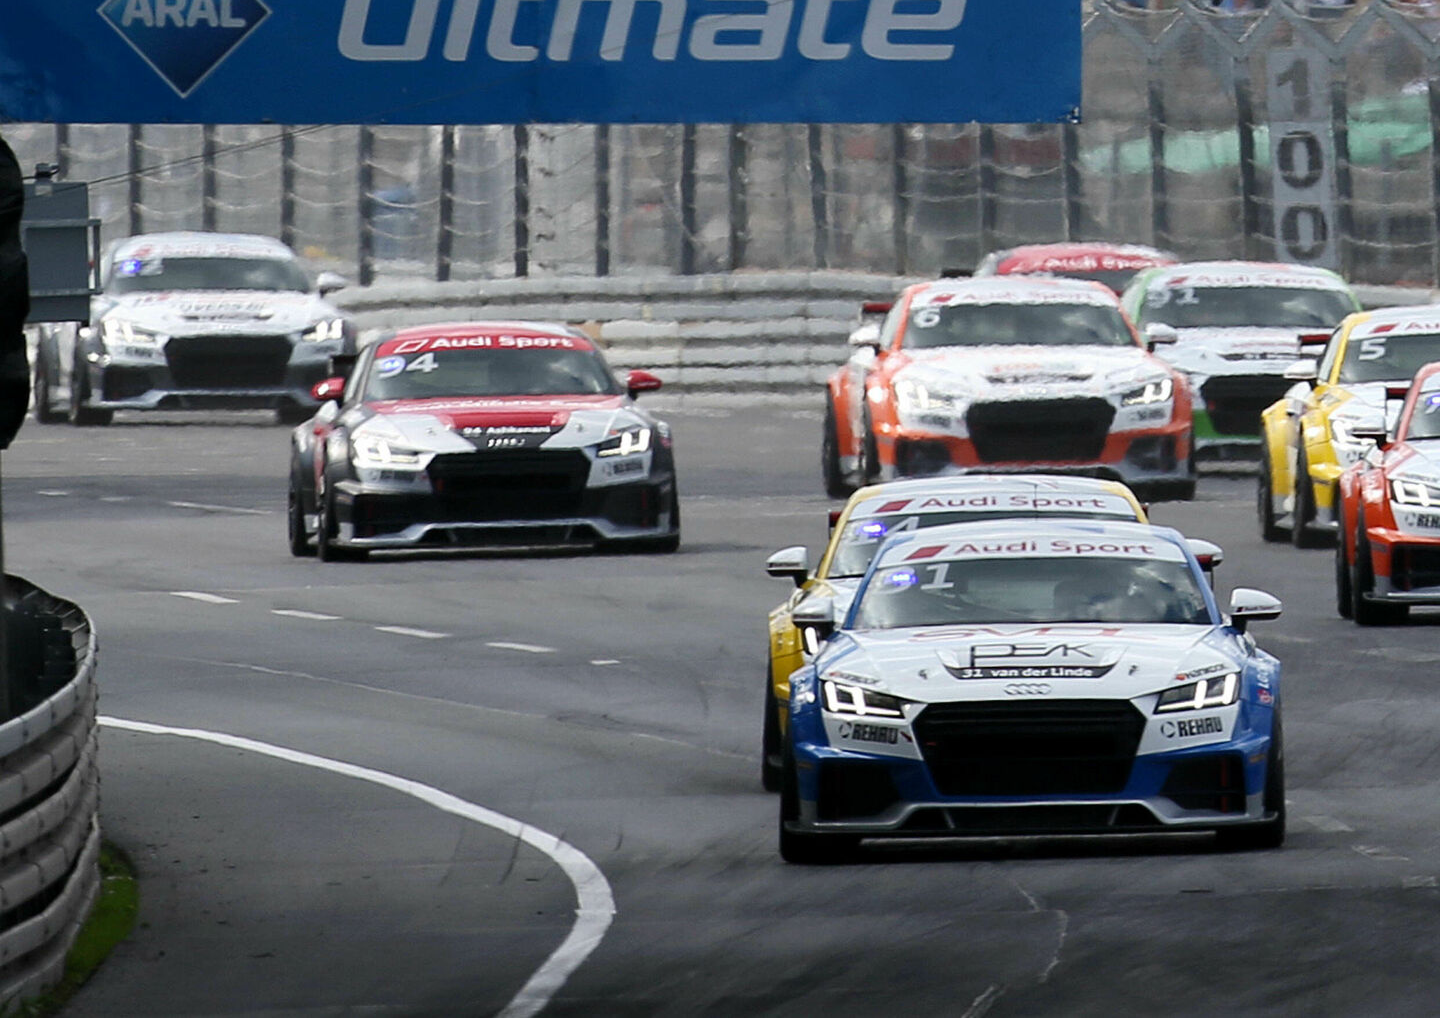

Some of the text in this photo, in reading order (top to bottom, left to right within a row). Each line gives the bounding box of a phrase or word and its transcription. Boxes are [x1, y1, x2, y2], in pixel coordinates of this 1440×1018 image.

[912, 308, 941, 329] 6
[430, 335, 574, 350] Audi Sport
[1358, 338, 1387, 361] 5
[919, 496, 1107, 511] Audi Sport
[953, 541, 1155, 556] Audi Sport
[962, 668, 983, 678] 31
[1022, 668, 1048, 677] der
[1051, 668, 1093, 677] Linde
[852, 723, 899, 744] REHAU
[1177, 716, 1223, 738] REHAU
